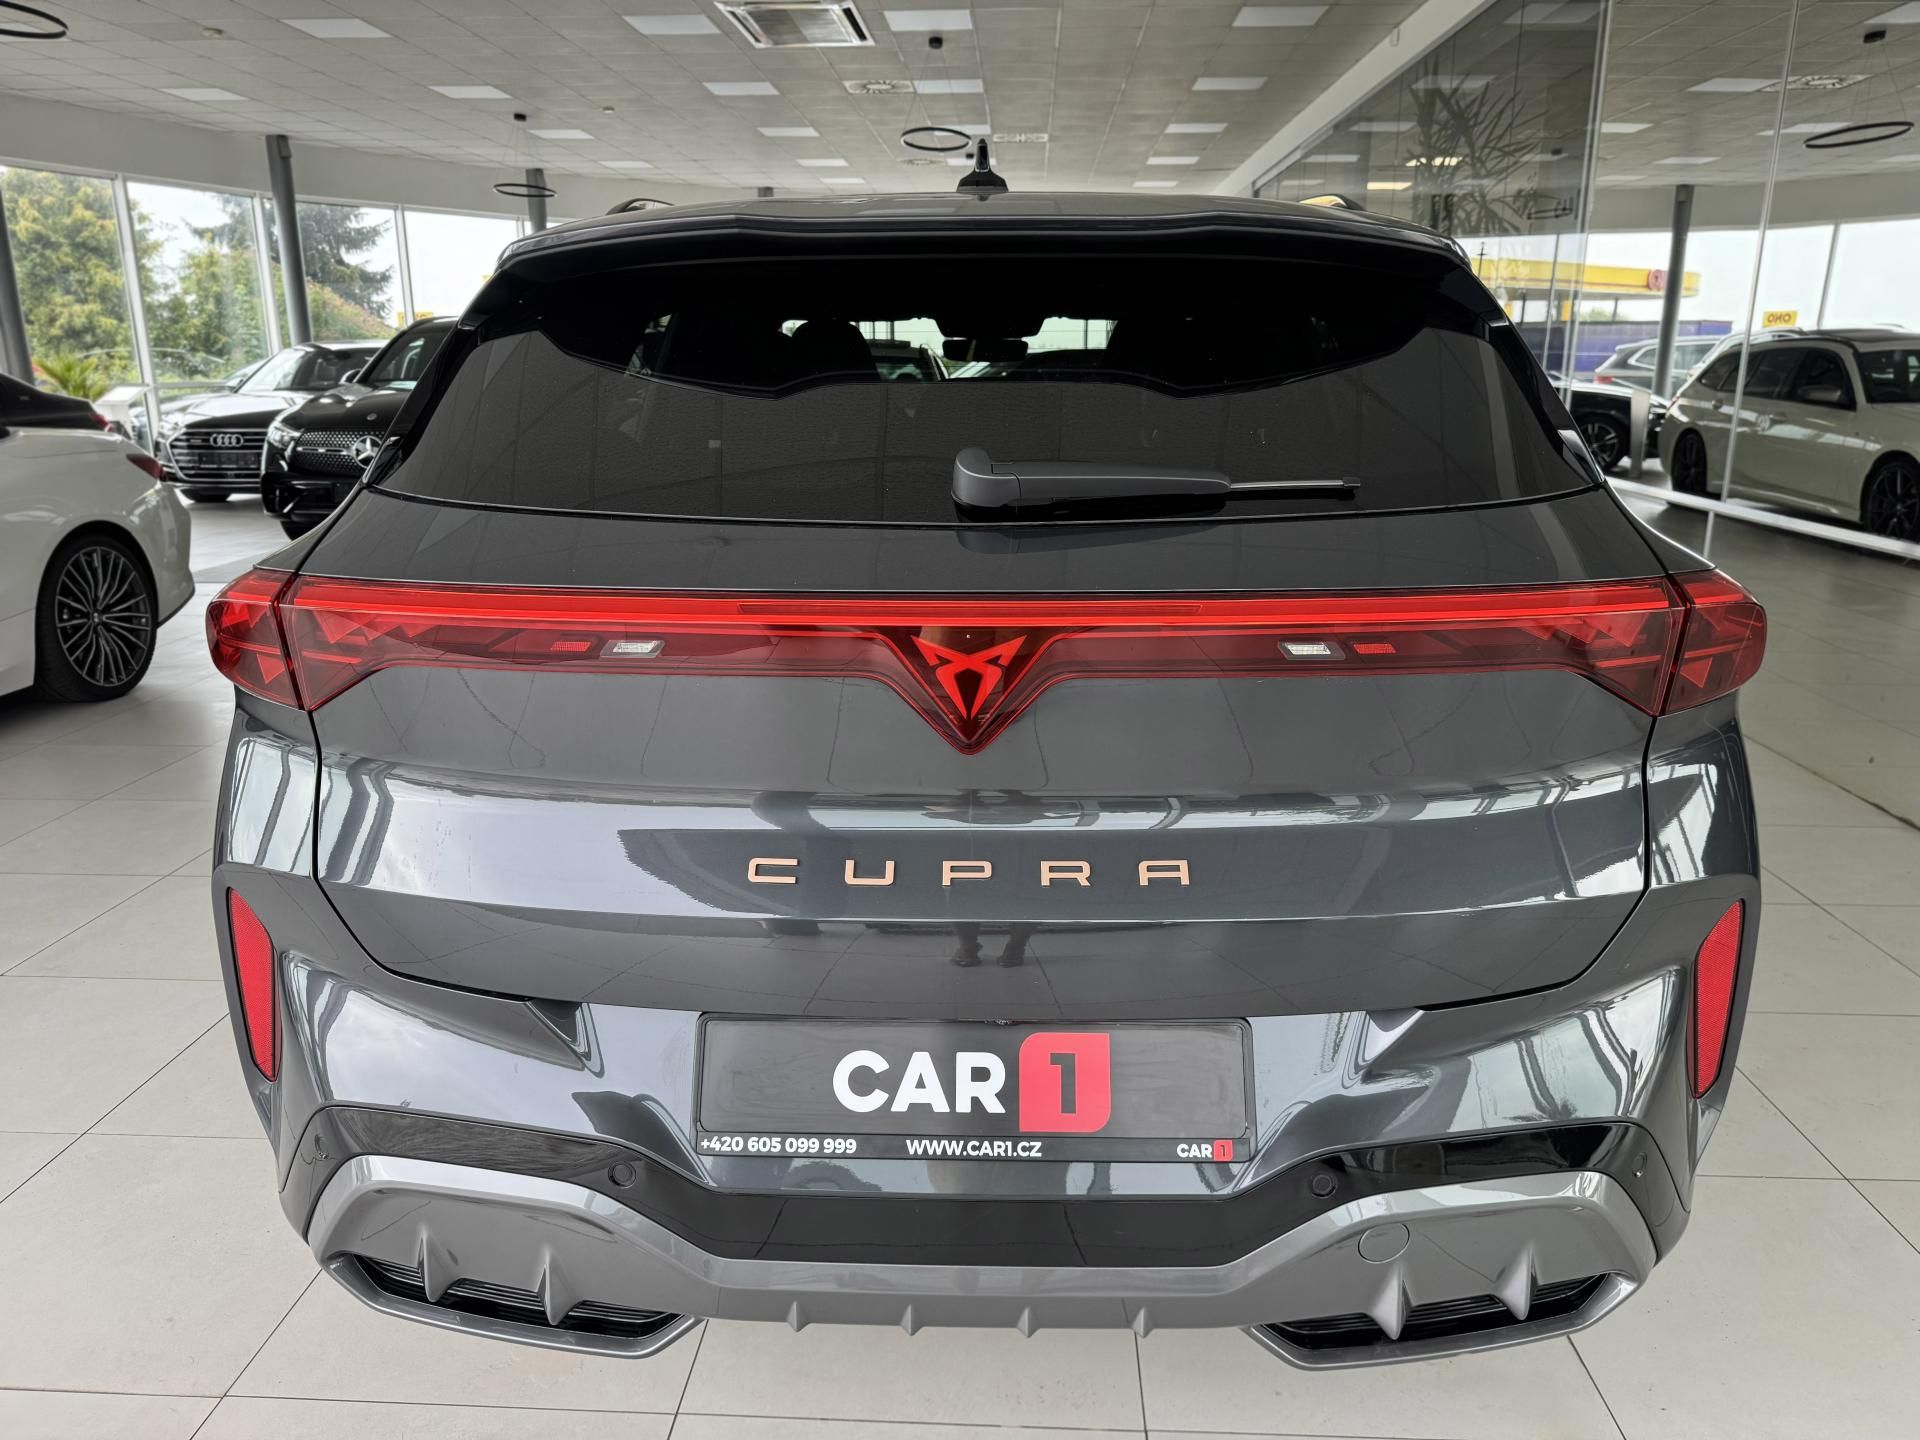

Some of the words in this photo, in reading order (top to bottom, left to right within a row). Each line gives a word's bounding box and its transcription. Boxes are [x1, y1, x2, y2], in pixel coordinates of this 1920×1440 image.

[747, 857, 1190, 887] CUPRA
[700, 1136, 744, 1152] +420
[748, 1137, 782, 1152] 605
[786, 1138, 820, 1153] 099
[823, 1139, 857, 1154] 999
[906, 1140, 1042, 1157] WWW.CAR1.CZ
